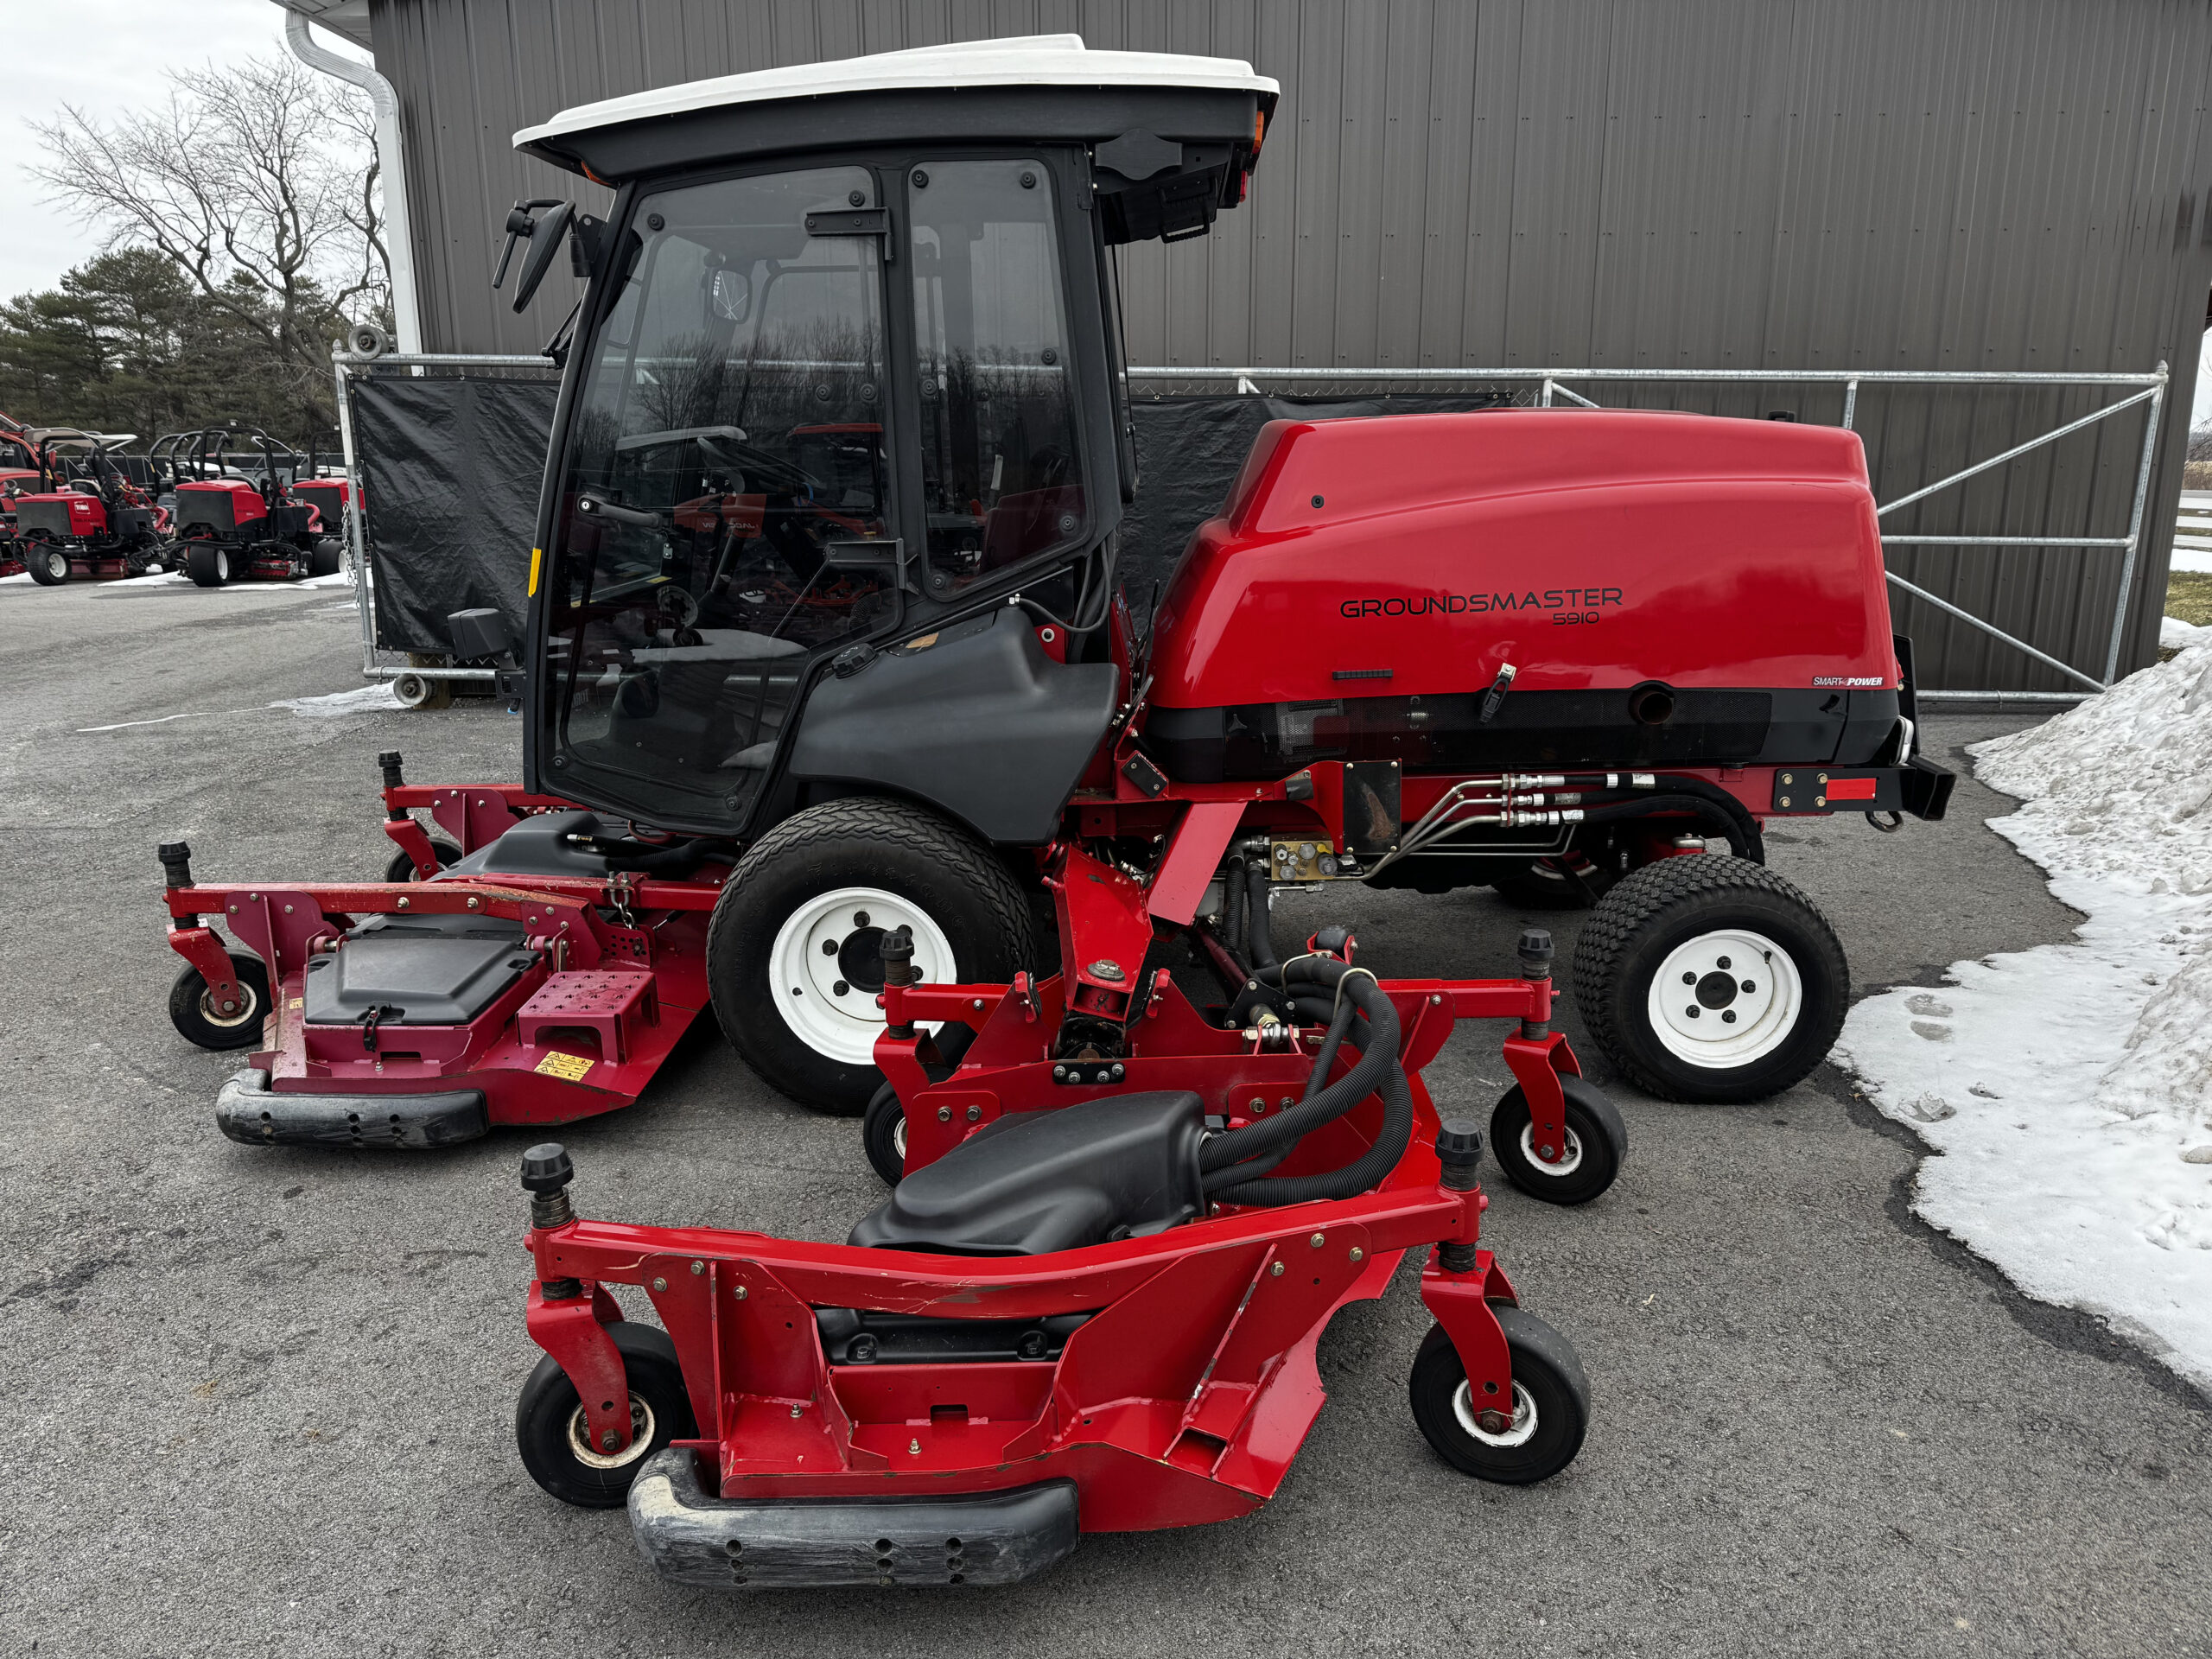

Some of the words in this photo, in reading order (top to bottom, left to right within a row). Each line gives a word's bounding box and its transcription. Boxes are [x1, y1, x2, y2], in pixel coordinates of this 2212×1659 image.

[1340, 588, 1624, 618] GROUNDSMASTER
[1553, 612, 1599, 626] 5910
[1813, 677, 1844, 686] SMART
[1847, 677, 1884, 686] POWER
